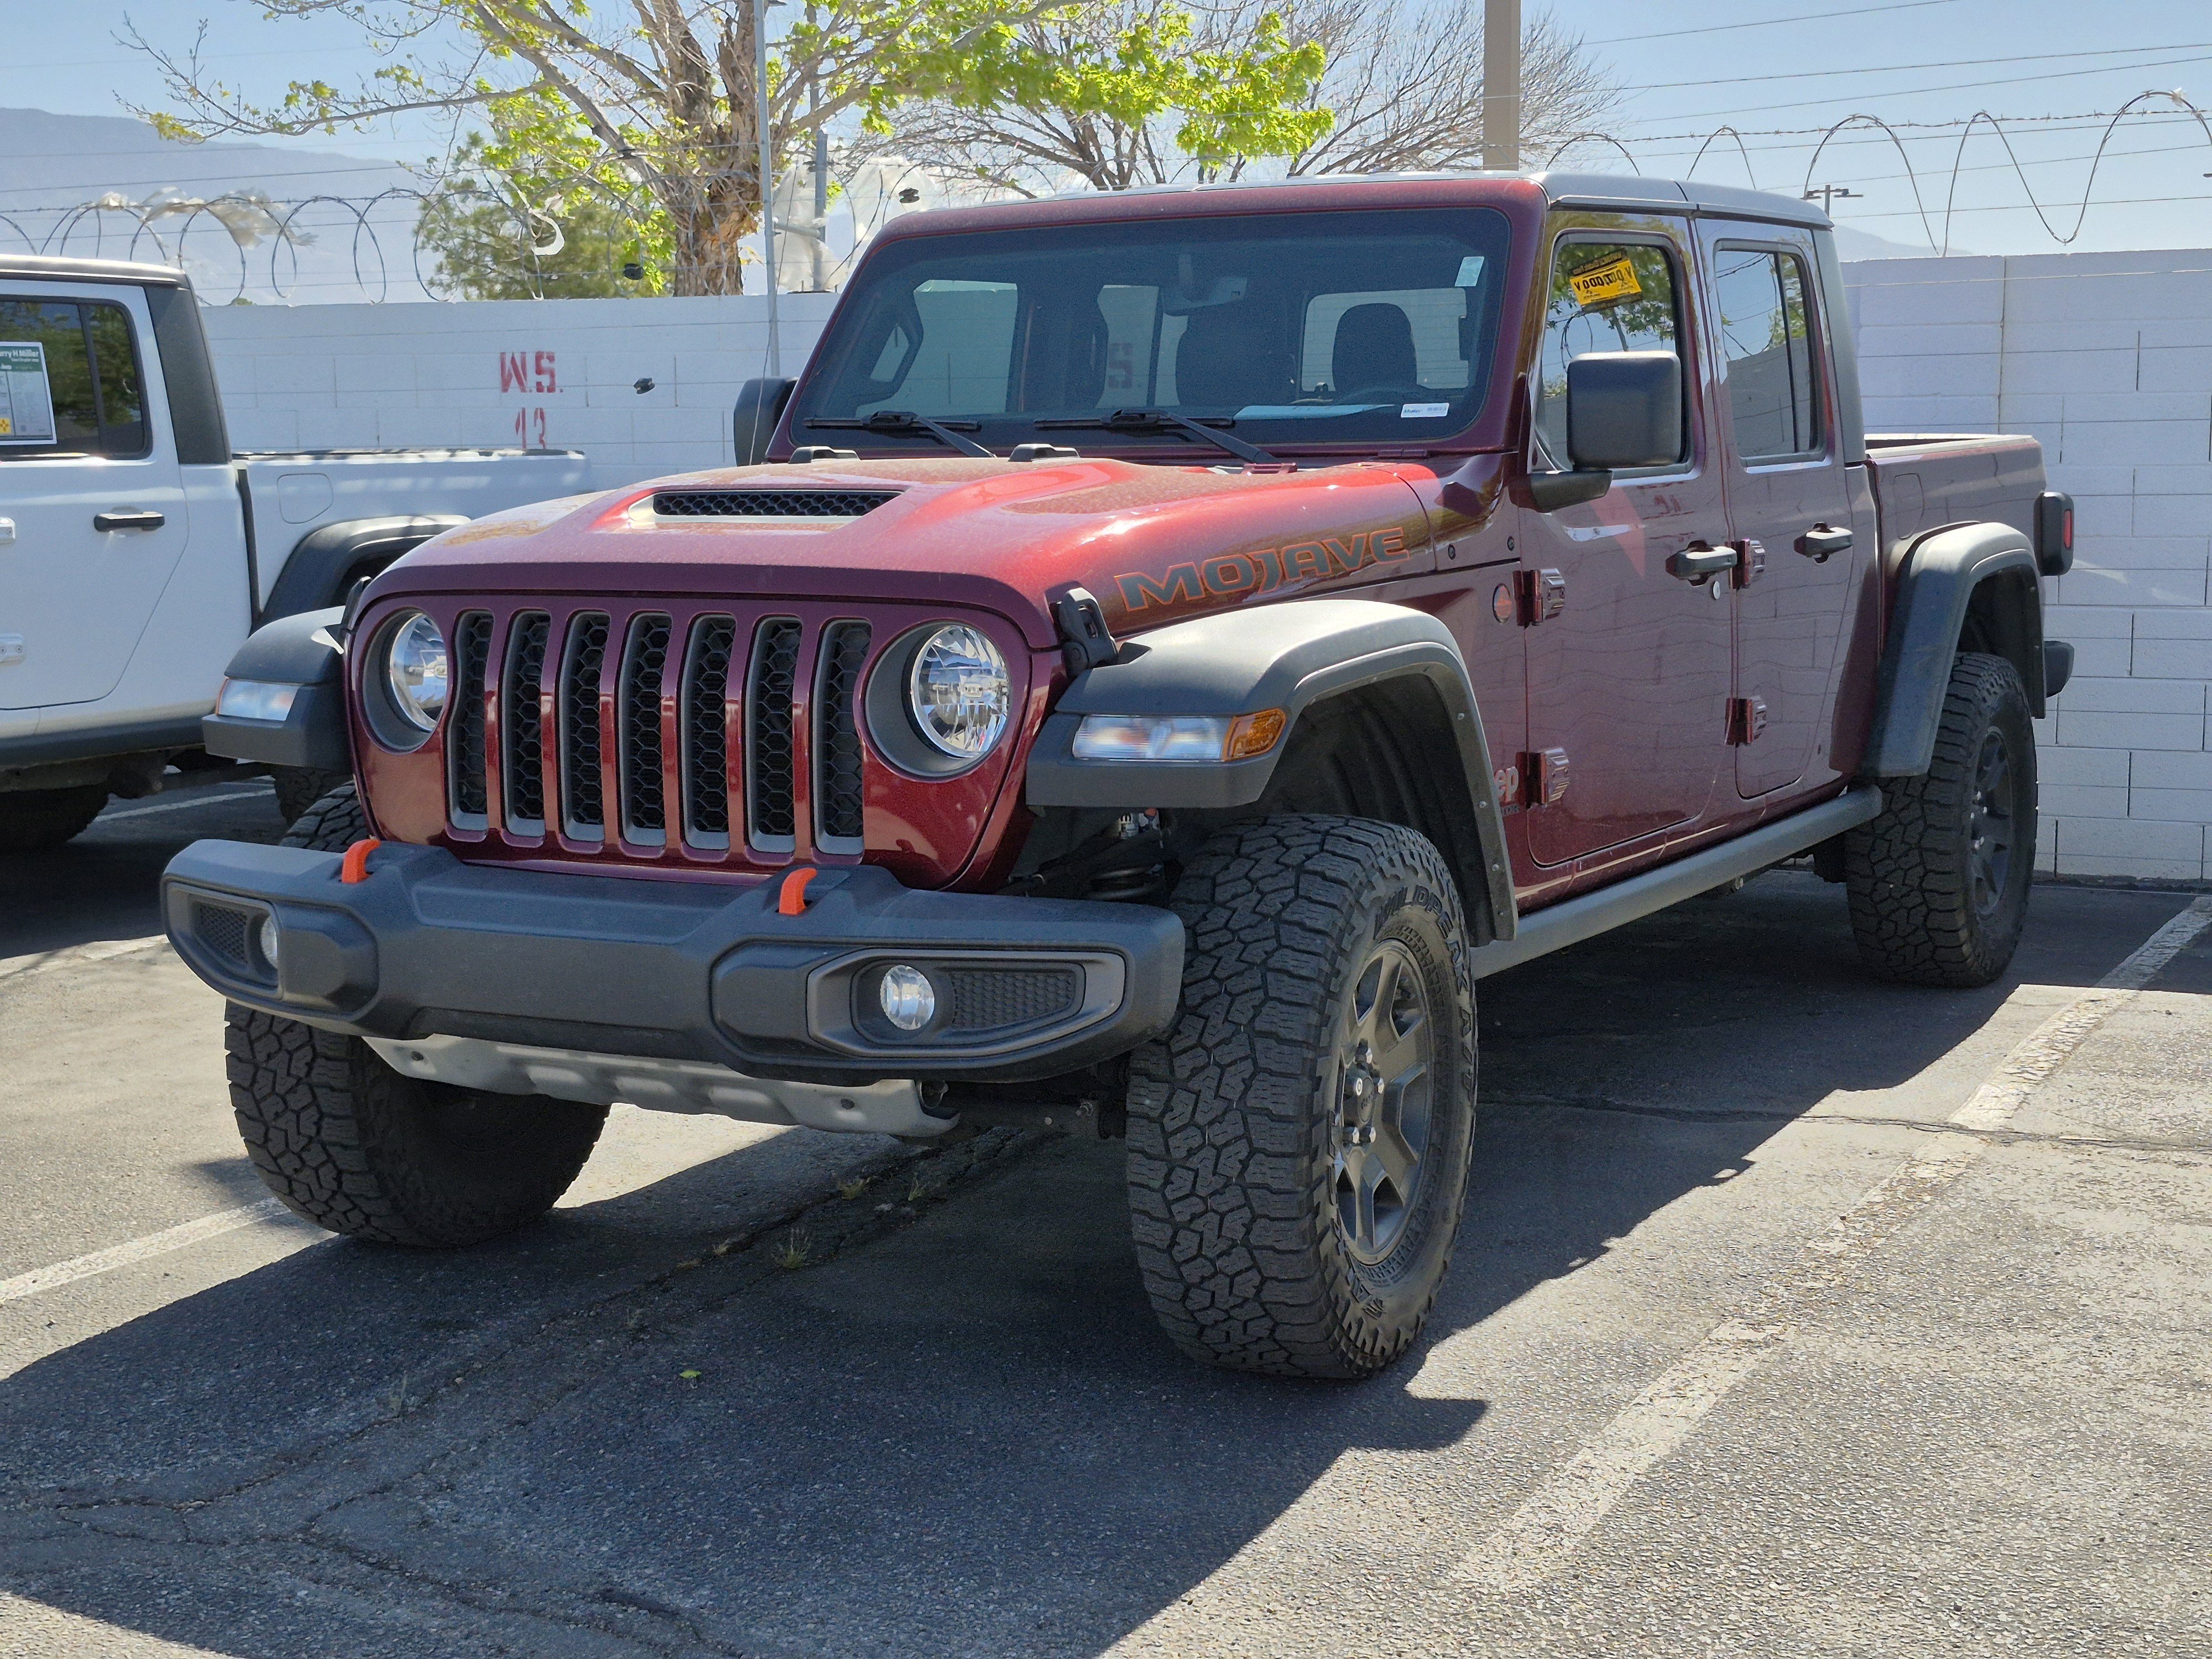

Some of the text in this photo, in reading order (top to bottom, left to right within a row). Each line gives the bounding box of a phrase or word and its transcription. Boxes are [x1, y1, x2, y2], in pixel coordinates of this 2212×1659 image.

[1114, 527, 1410, 612] MOJAVE
[1493, 766, 1519, 802] ep
[1373, 885, 1469, 995] WILDPEAK
